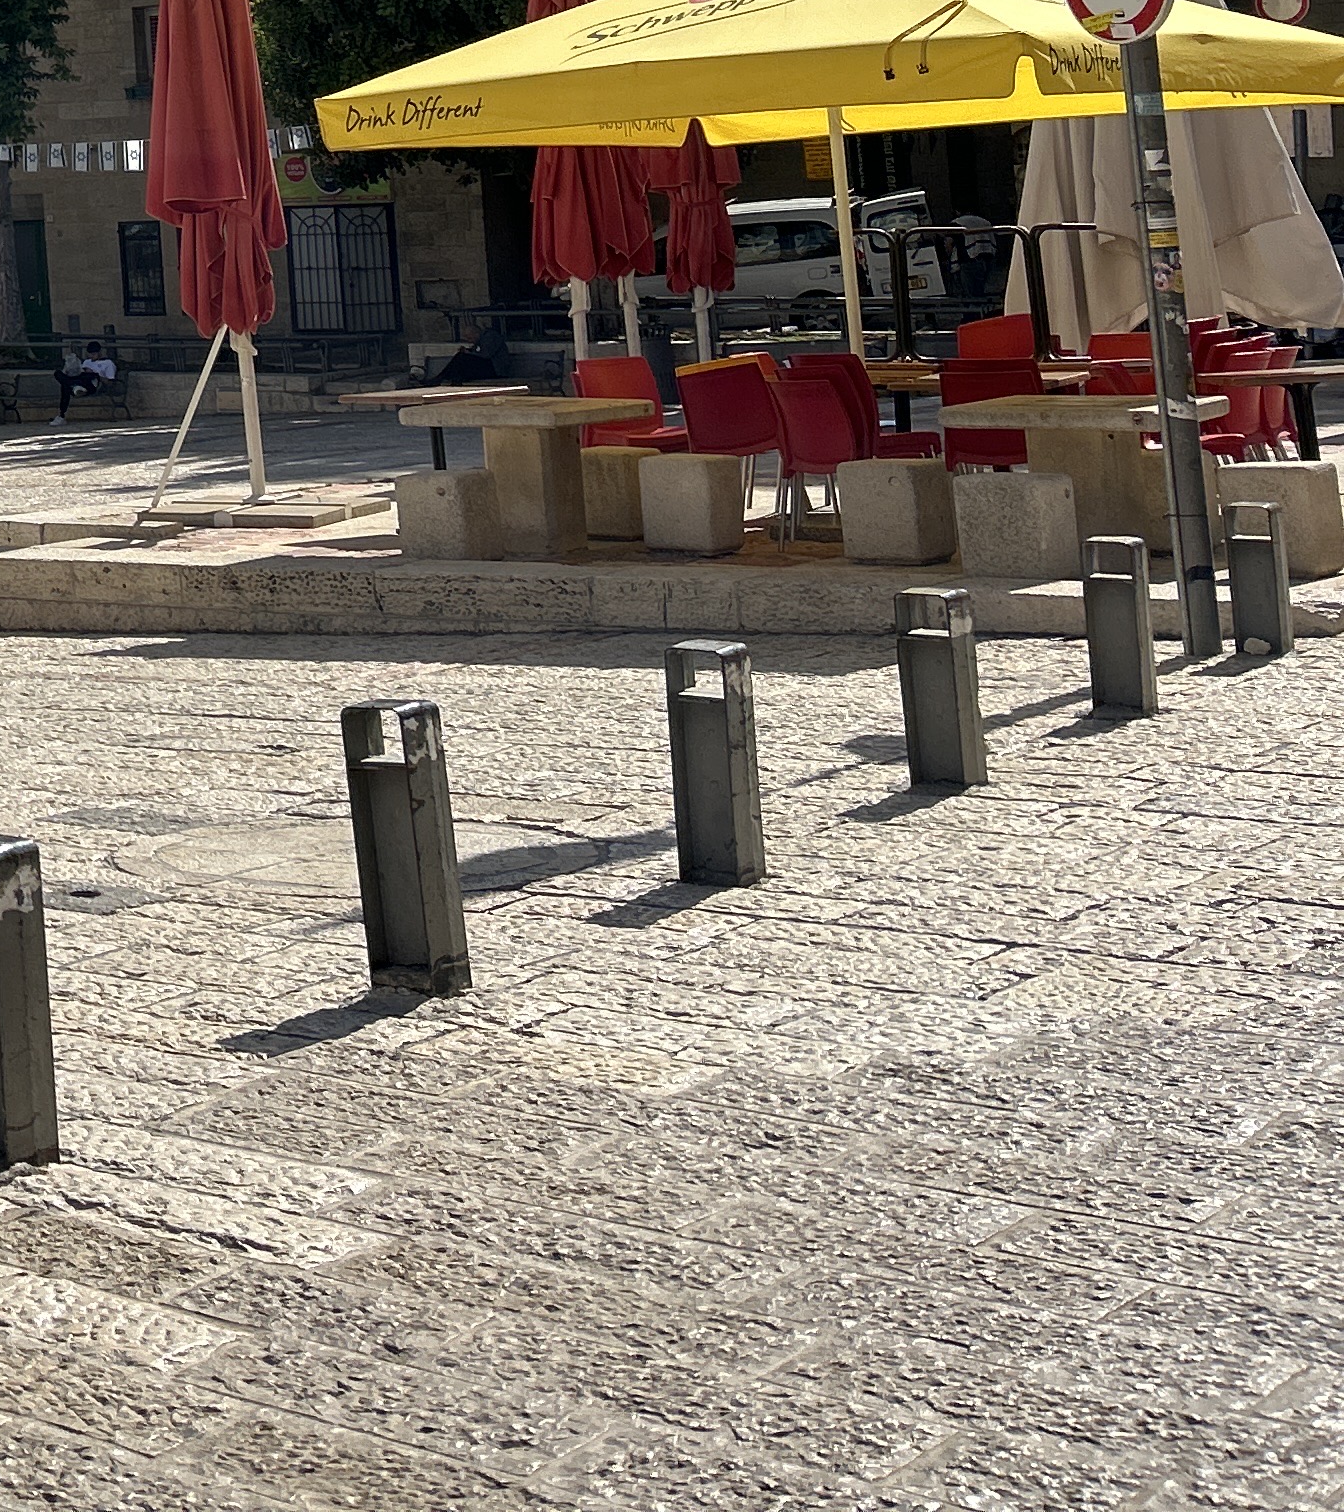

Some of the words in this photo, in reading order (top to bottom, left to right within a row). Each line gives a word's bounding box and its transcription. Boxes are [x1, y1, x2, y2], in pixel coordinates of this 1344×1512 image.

[1050, 44, 1081, 76] Drink
[1083, 43, 1122, 81] Differe
[345, 103, 395, 133] Drink
[402, 95, 484, 130] Different
